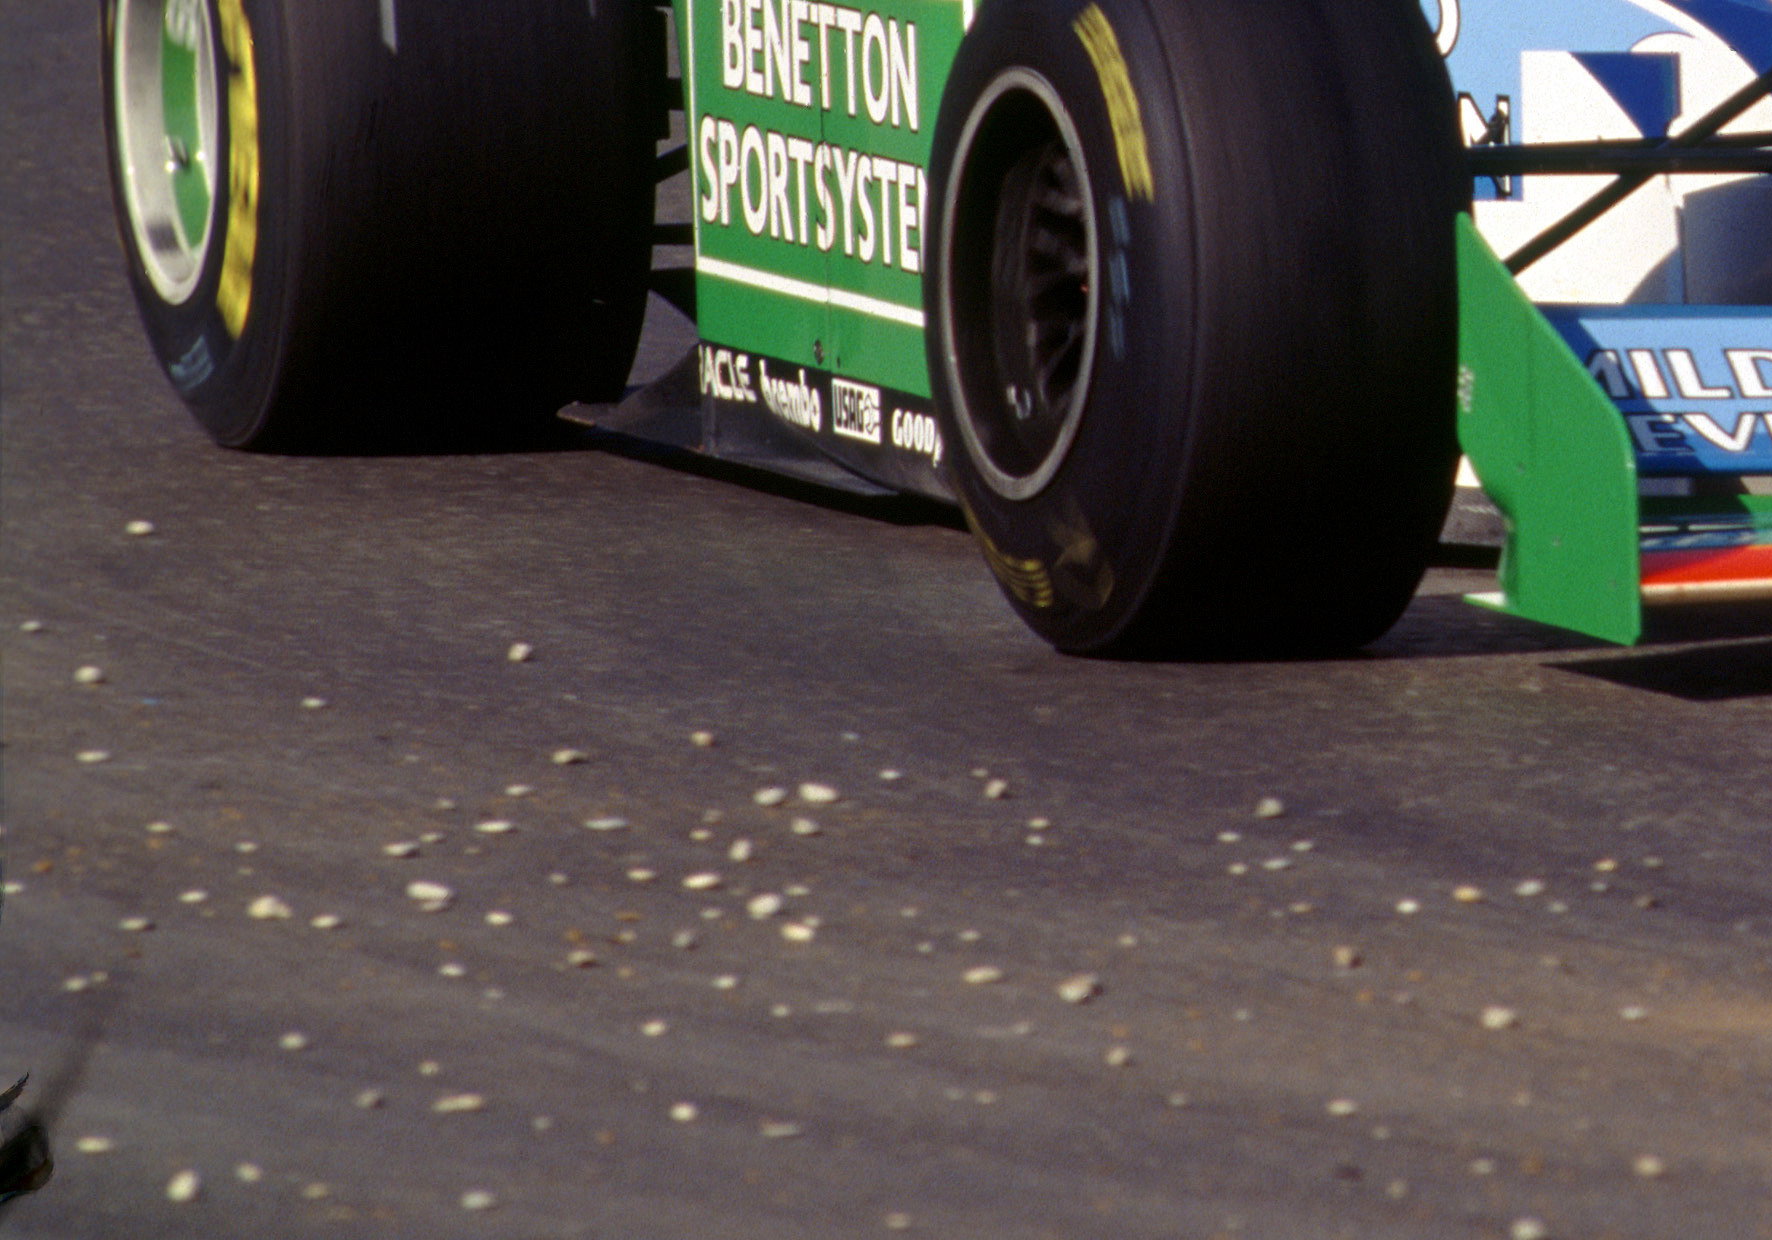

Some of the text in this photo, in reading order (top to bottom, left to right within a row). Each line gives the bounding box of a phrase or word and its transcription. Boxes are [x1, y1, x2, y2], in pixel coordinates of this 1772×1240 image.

[758, 359, 821, 433] brembo
[832, 382, 864, 434] USAG
[891, 407, 943, 467] GOOD
